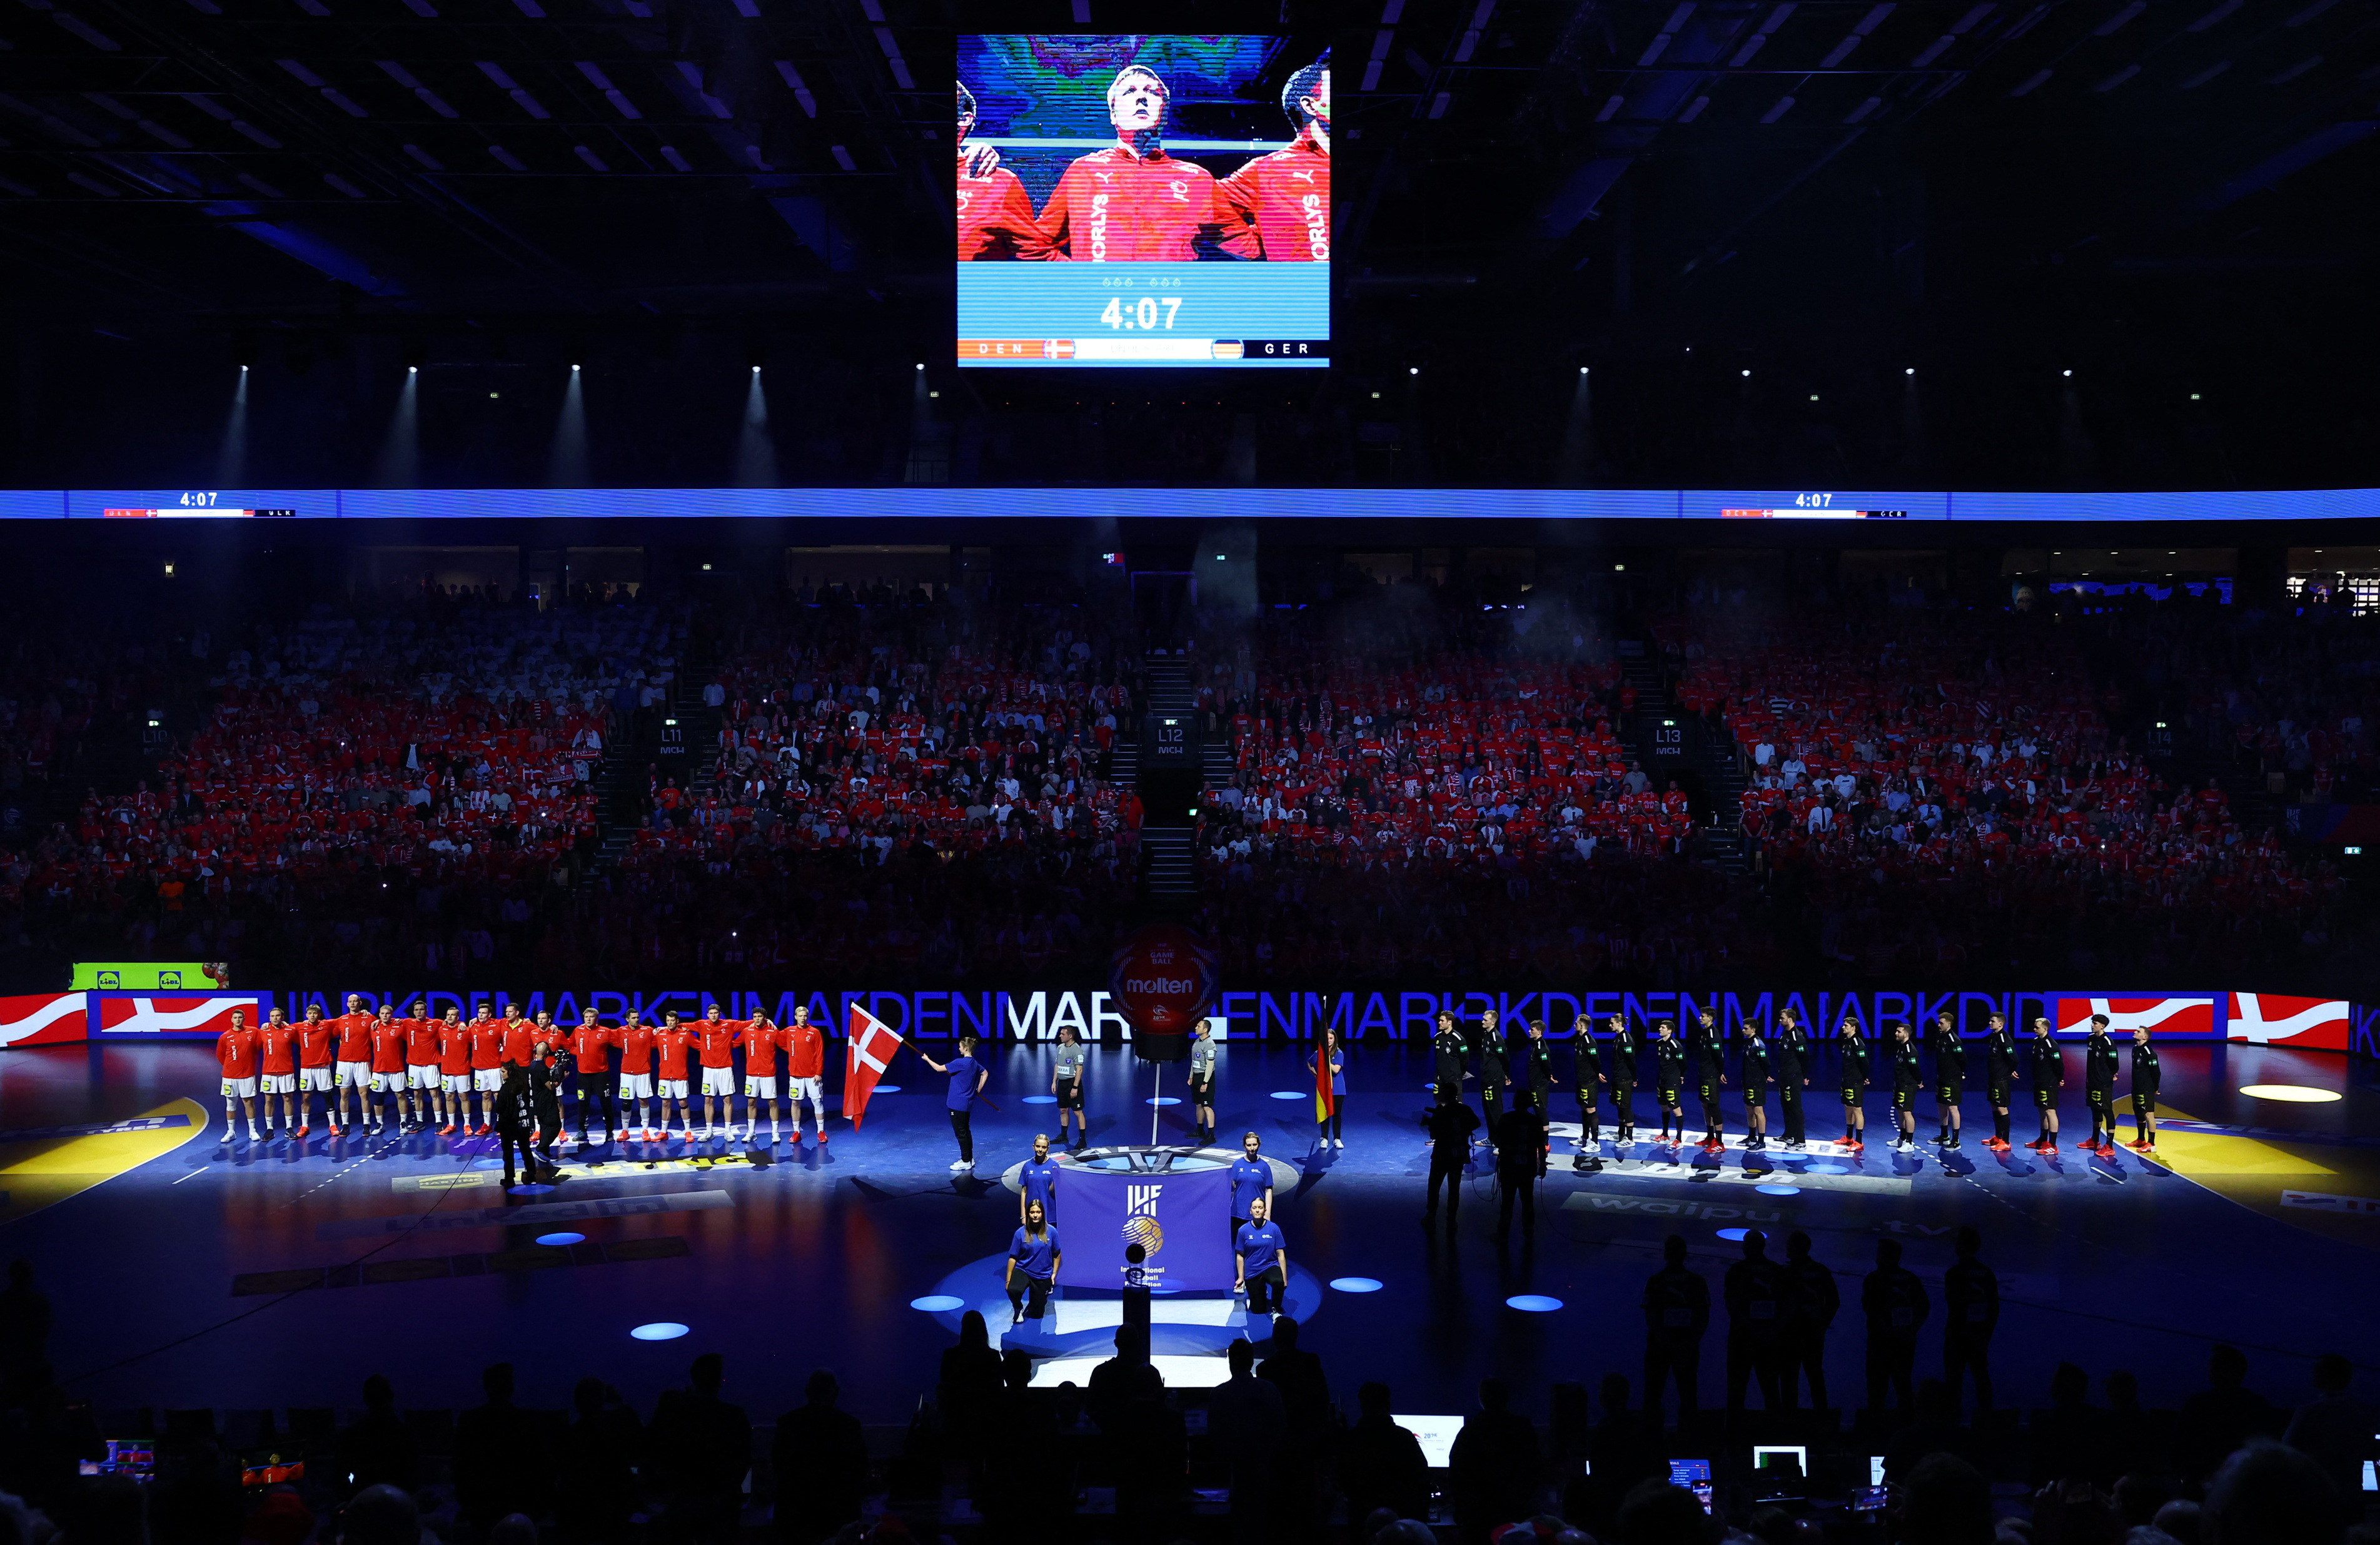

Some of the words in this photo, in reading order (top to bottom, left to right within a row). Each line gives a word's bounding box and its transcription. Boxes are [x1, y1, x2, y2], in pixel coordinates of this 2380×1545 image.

[1100, 297, 1182, 330] 4:07
[979, 343, 1022, 354] DEN
[1264, 343, 1309, 354] GER
[180, 492, 217, 506] 4:07
[1795, 493, 1832, 507] 4:07
[1158, 728, 1183, 742] L12
[1656, 729, 1681, 742] L13
[661, 747, 682, 761] L11
[1656, 747, 1681, 755] MCH
[660, 765, 685, 773] MCH
[1126, 977, 1193, 994] molten
[603, 1088, 610, 1098] 12
[86, 1124, 161, 1135] TYRES
[1126, 1184, 1163, 1217] IHF
[1591, 1197, 1781, 1222] waipu
